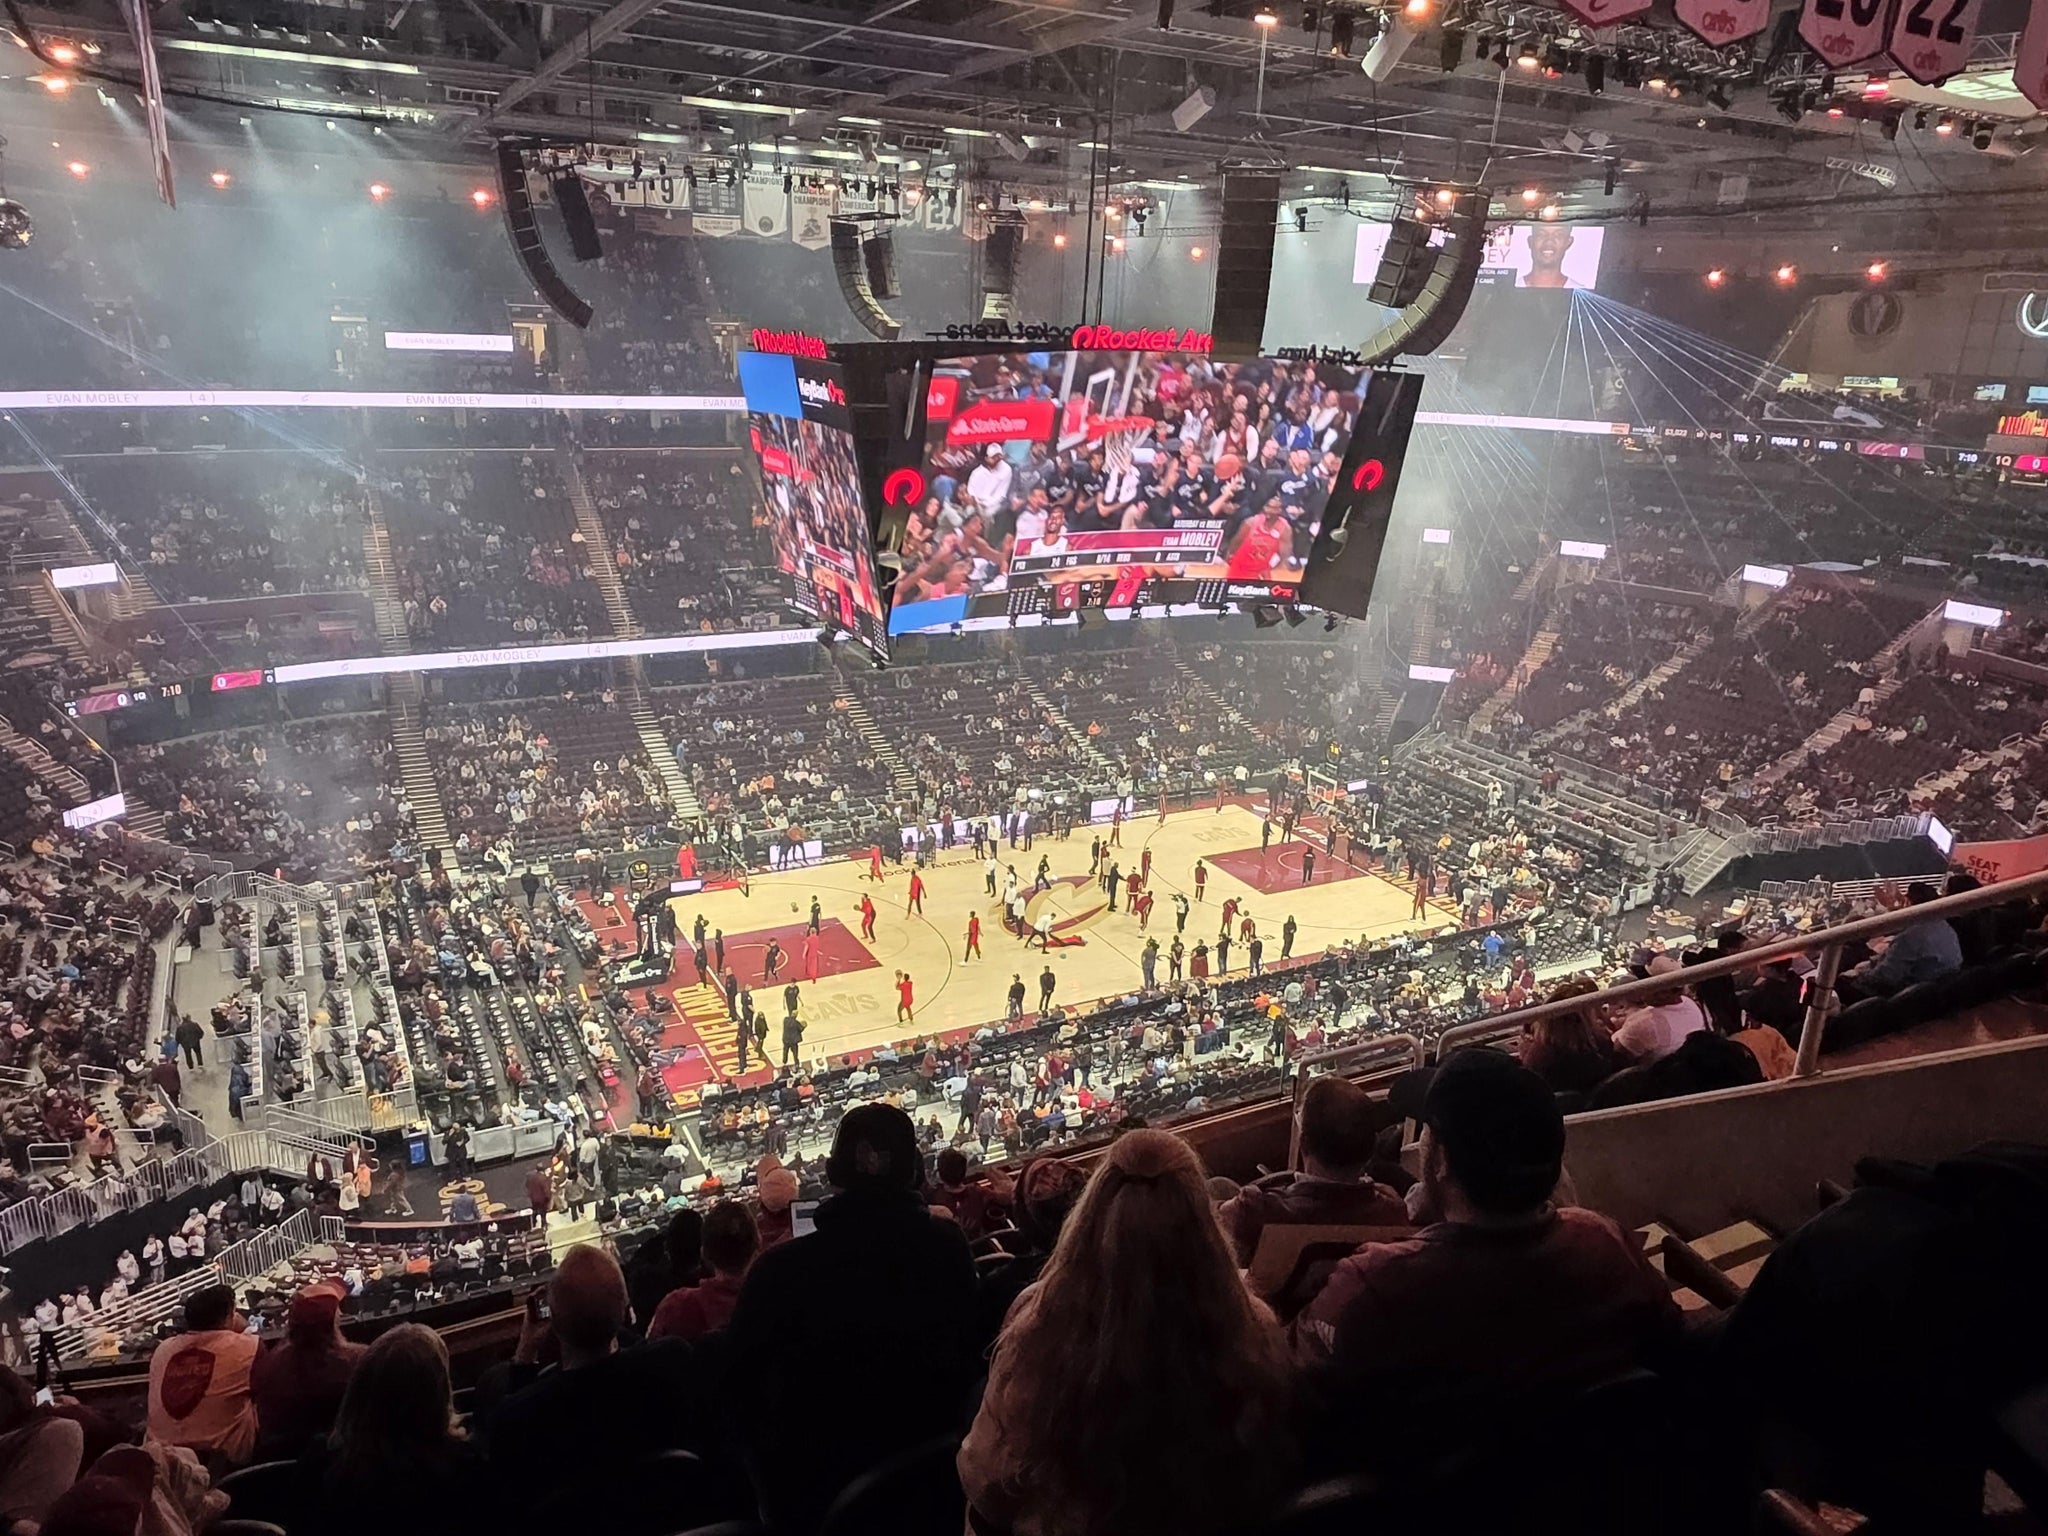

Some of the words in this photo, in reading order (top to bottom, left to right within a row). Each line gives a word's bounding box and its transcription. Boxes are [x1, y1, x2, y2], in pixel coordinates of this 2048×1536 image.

[1095, 325, 1177, 351] Rocket
[47, 393, 82, 404] EVAN
[86, 392, 139, 404] MOBLEY
[406, 395, 437, 405] EVAN
[438, 396, 482, 405] MOBLEY
[703, 399, 726, 408] EVAN
[1900, 446, 1908, 457] 0
[2033, 459, 2041, 469] 0
[1179, 532, 1219, 547] MOBLEY
[1227, 585, 1270, 597] KeyBank
[1064, 597, 1072, 607] 0
[781, 631, 808, 642] EVAN
[457, 652, 487, 664] EVAN
[217, 677, 226, 688] 0
[161, 684, 182, 697] 7:10
[117, 694, 127, 705] 0
[1193, 826, 1250, 843] CAVS
[1967, 855, 2001, 872] SEAT
[799, 992, 881, 1023] CAVS
